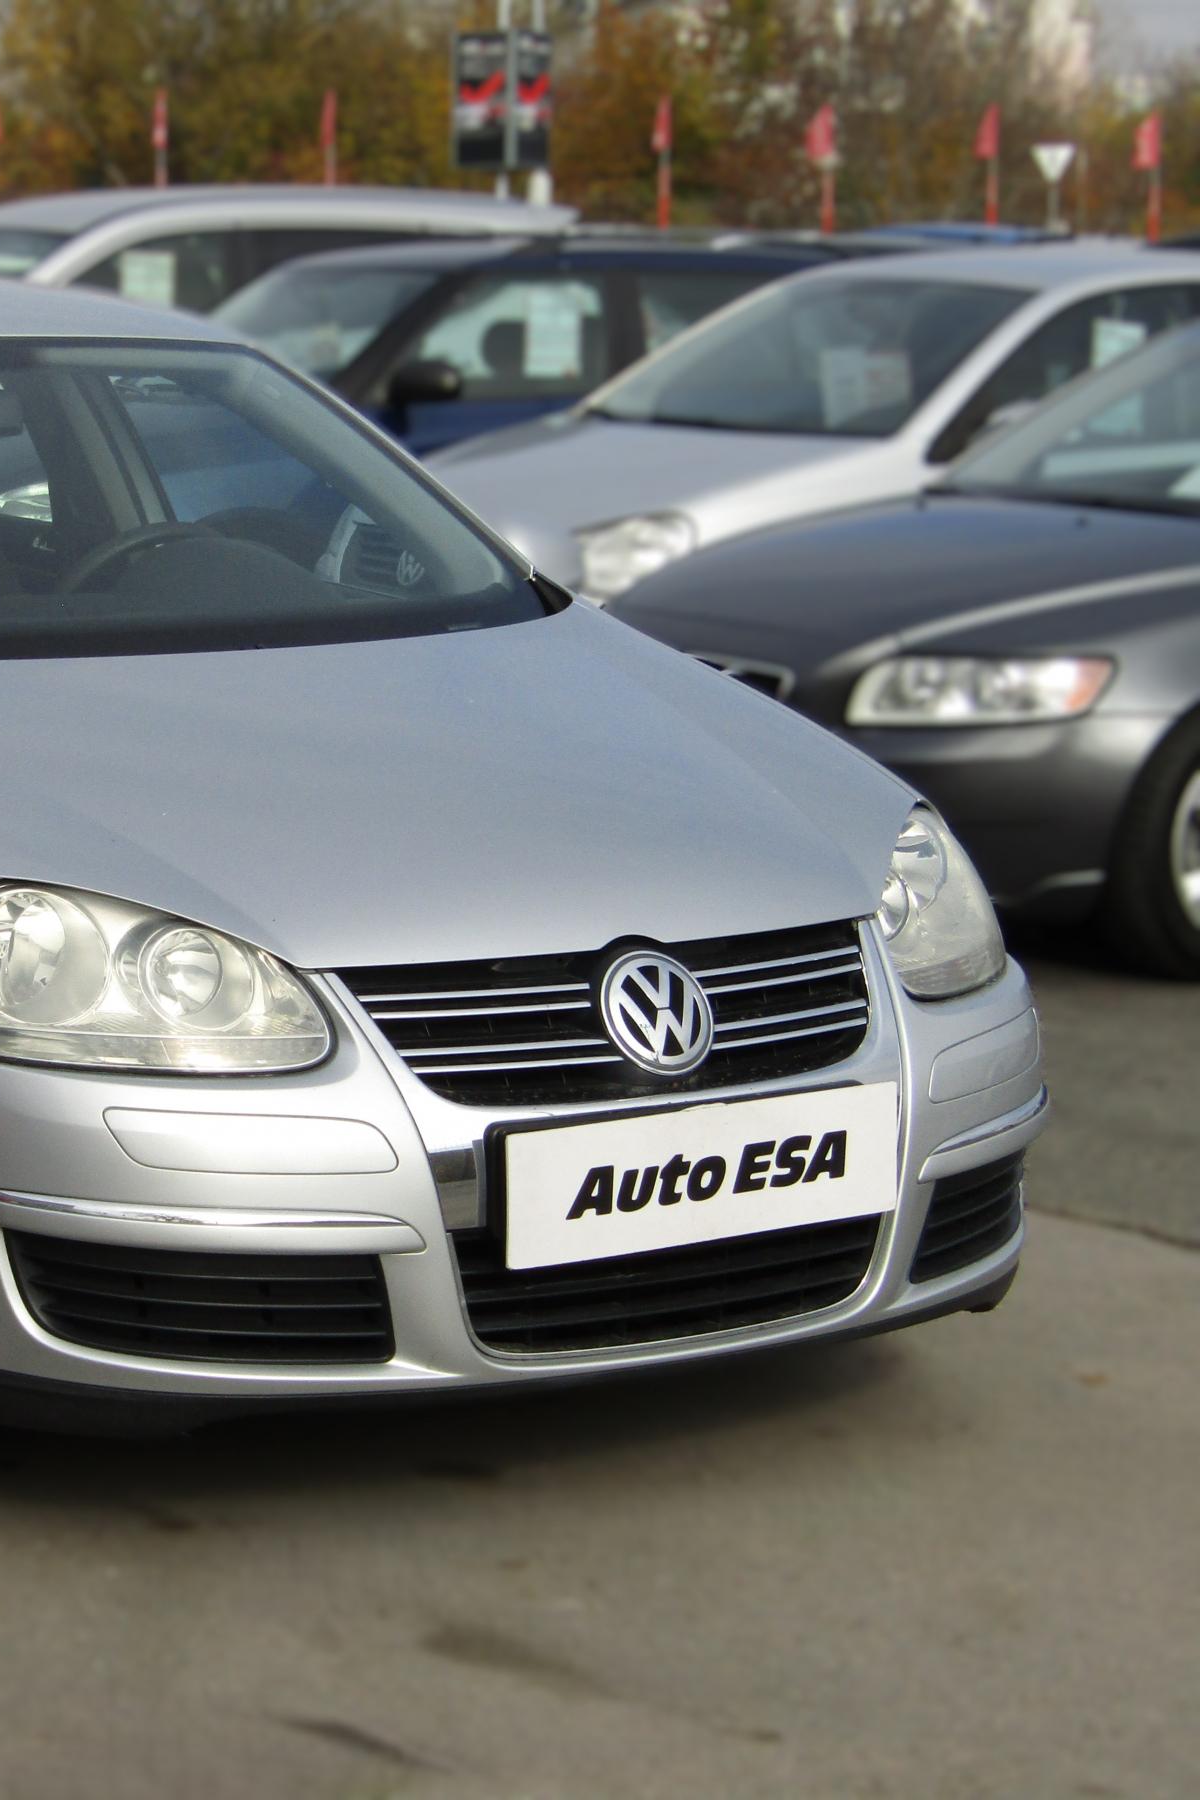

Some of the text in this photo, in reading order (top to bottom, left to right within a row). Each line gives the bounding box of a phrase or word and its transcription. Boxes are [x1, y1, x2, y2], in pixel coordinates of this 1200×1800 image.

[603, 953, 711, 1071] VW
[565, 1129, 847, 1220] Auto ESA
